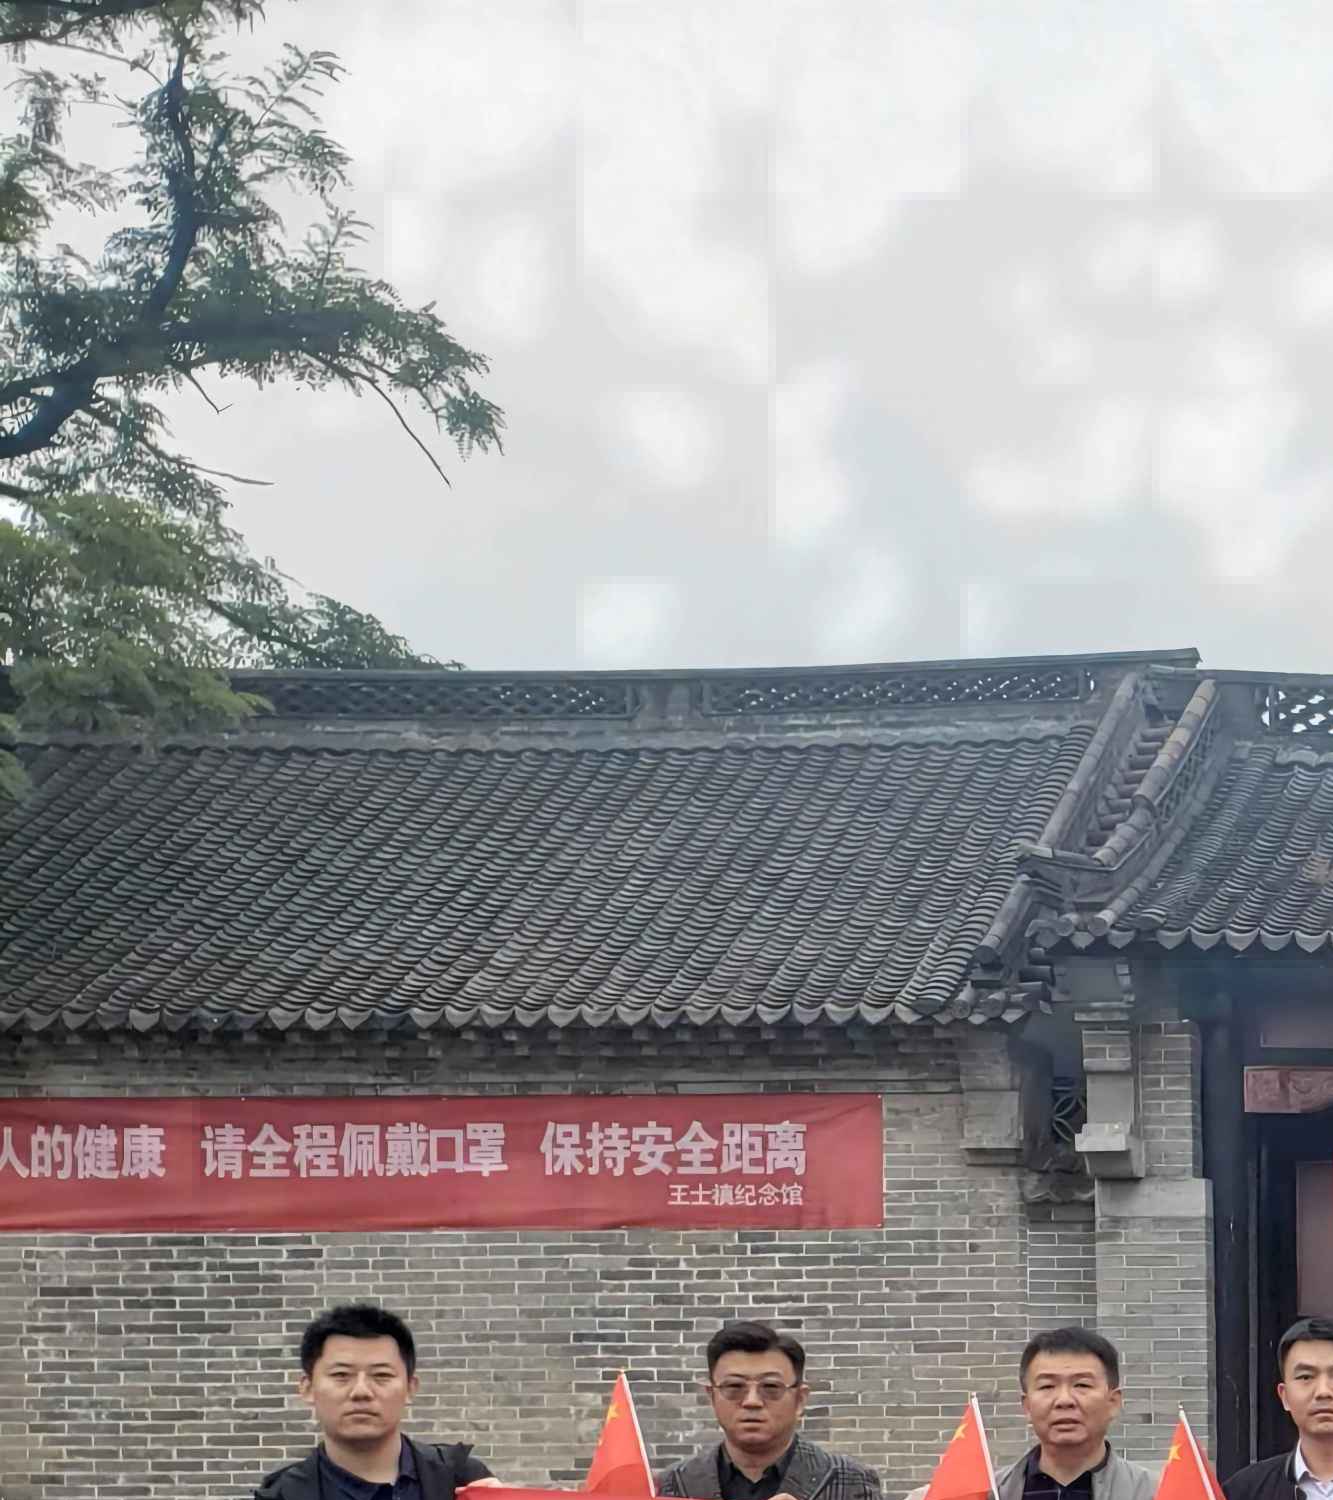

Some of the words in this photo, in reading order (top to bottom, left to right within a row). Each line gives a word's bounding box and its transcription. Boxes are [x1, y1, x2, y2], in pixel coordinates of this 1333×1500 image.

[0, 1124, 166, 1179] 人的健康
[201, 1122, 508, 1178] 请全程佩戴口罩
[540, 1120, 807, 1176] 保持安全距离
